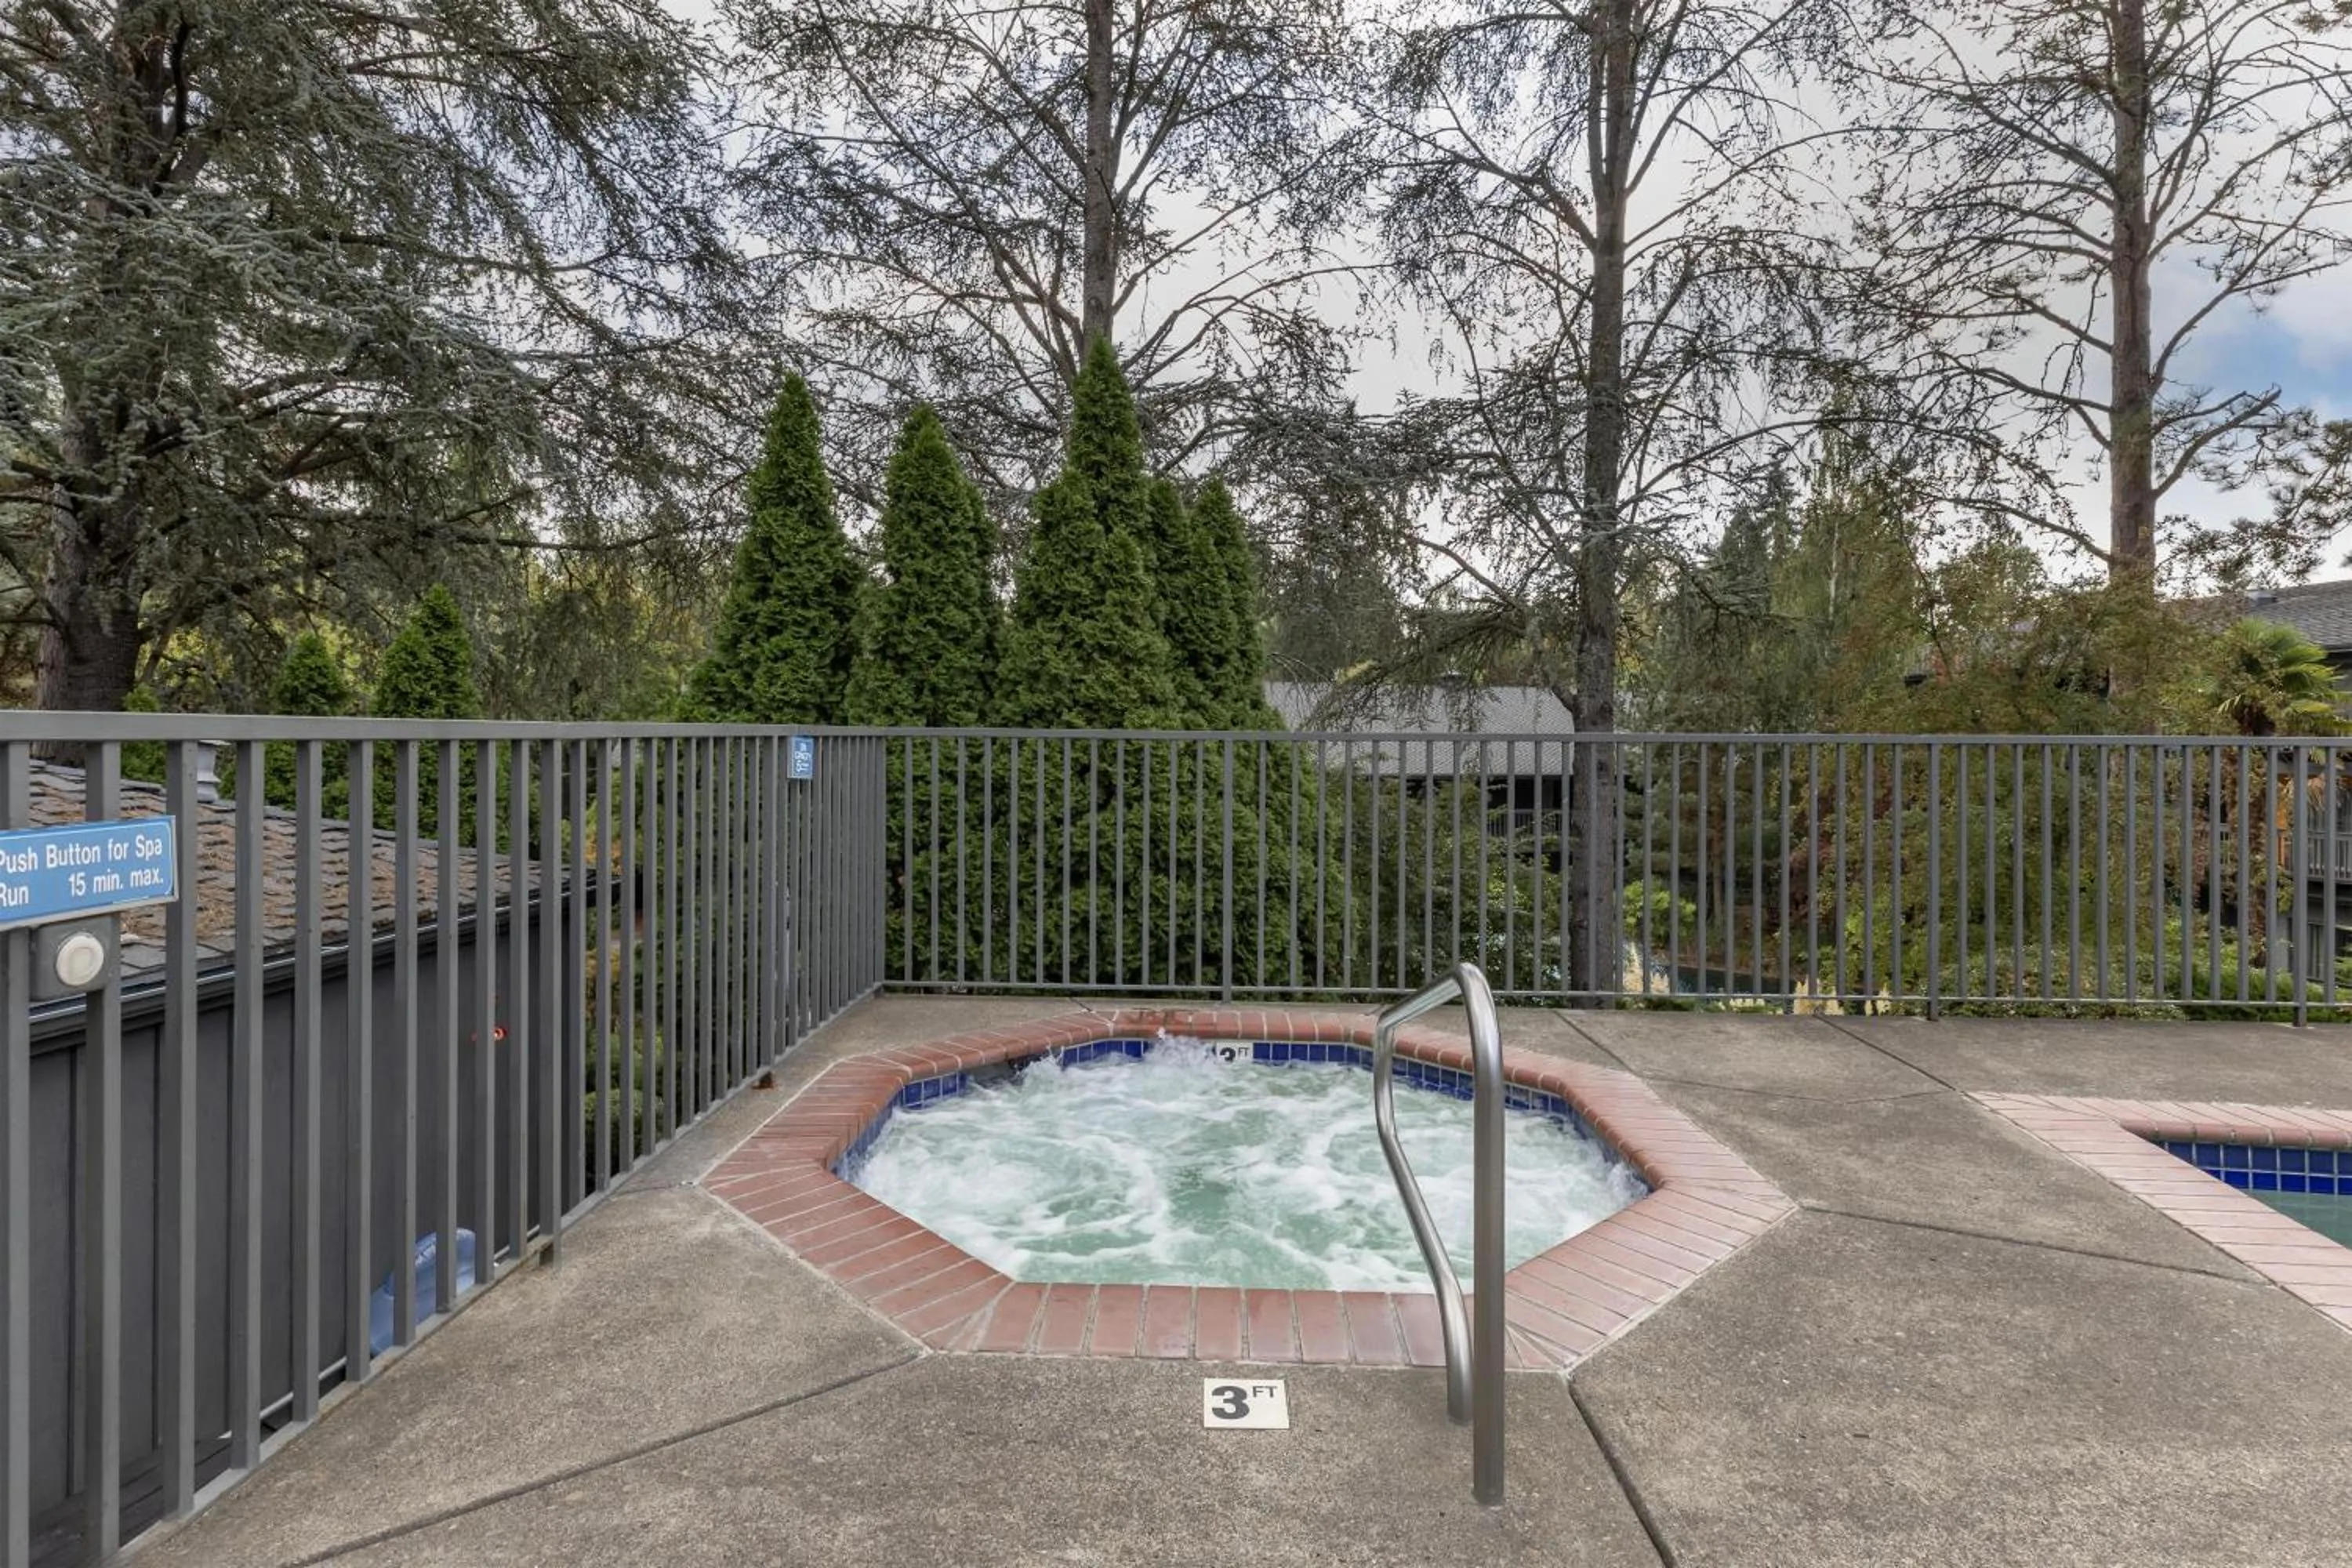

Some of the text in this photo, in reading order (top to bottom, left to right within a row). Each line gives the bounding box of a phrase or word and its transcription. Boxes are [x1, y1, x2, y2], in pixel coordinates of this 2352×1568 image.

[45, 843, 101, 869] Button
[108, 838, 129, 861] for
[135, 834, 162, 861] Spa
[68, 872, 85, 897] 15
[93, 868, 123, 894] min.
[130, 866, 163, 887] max.
